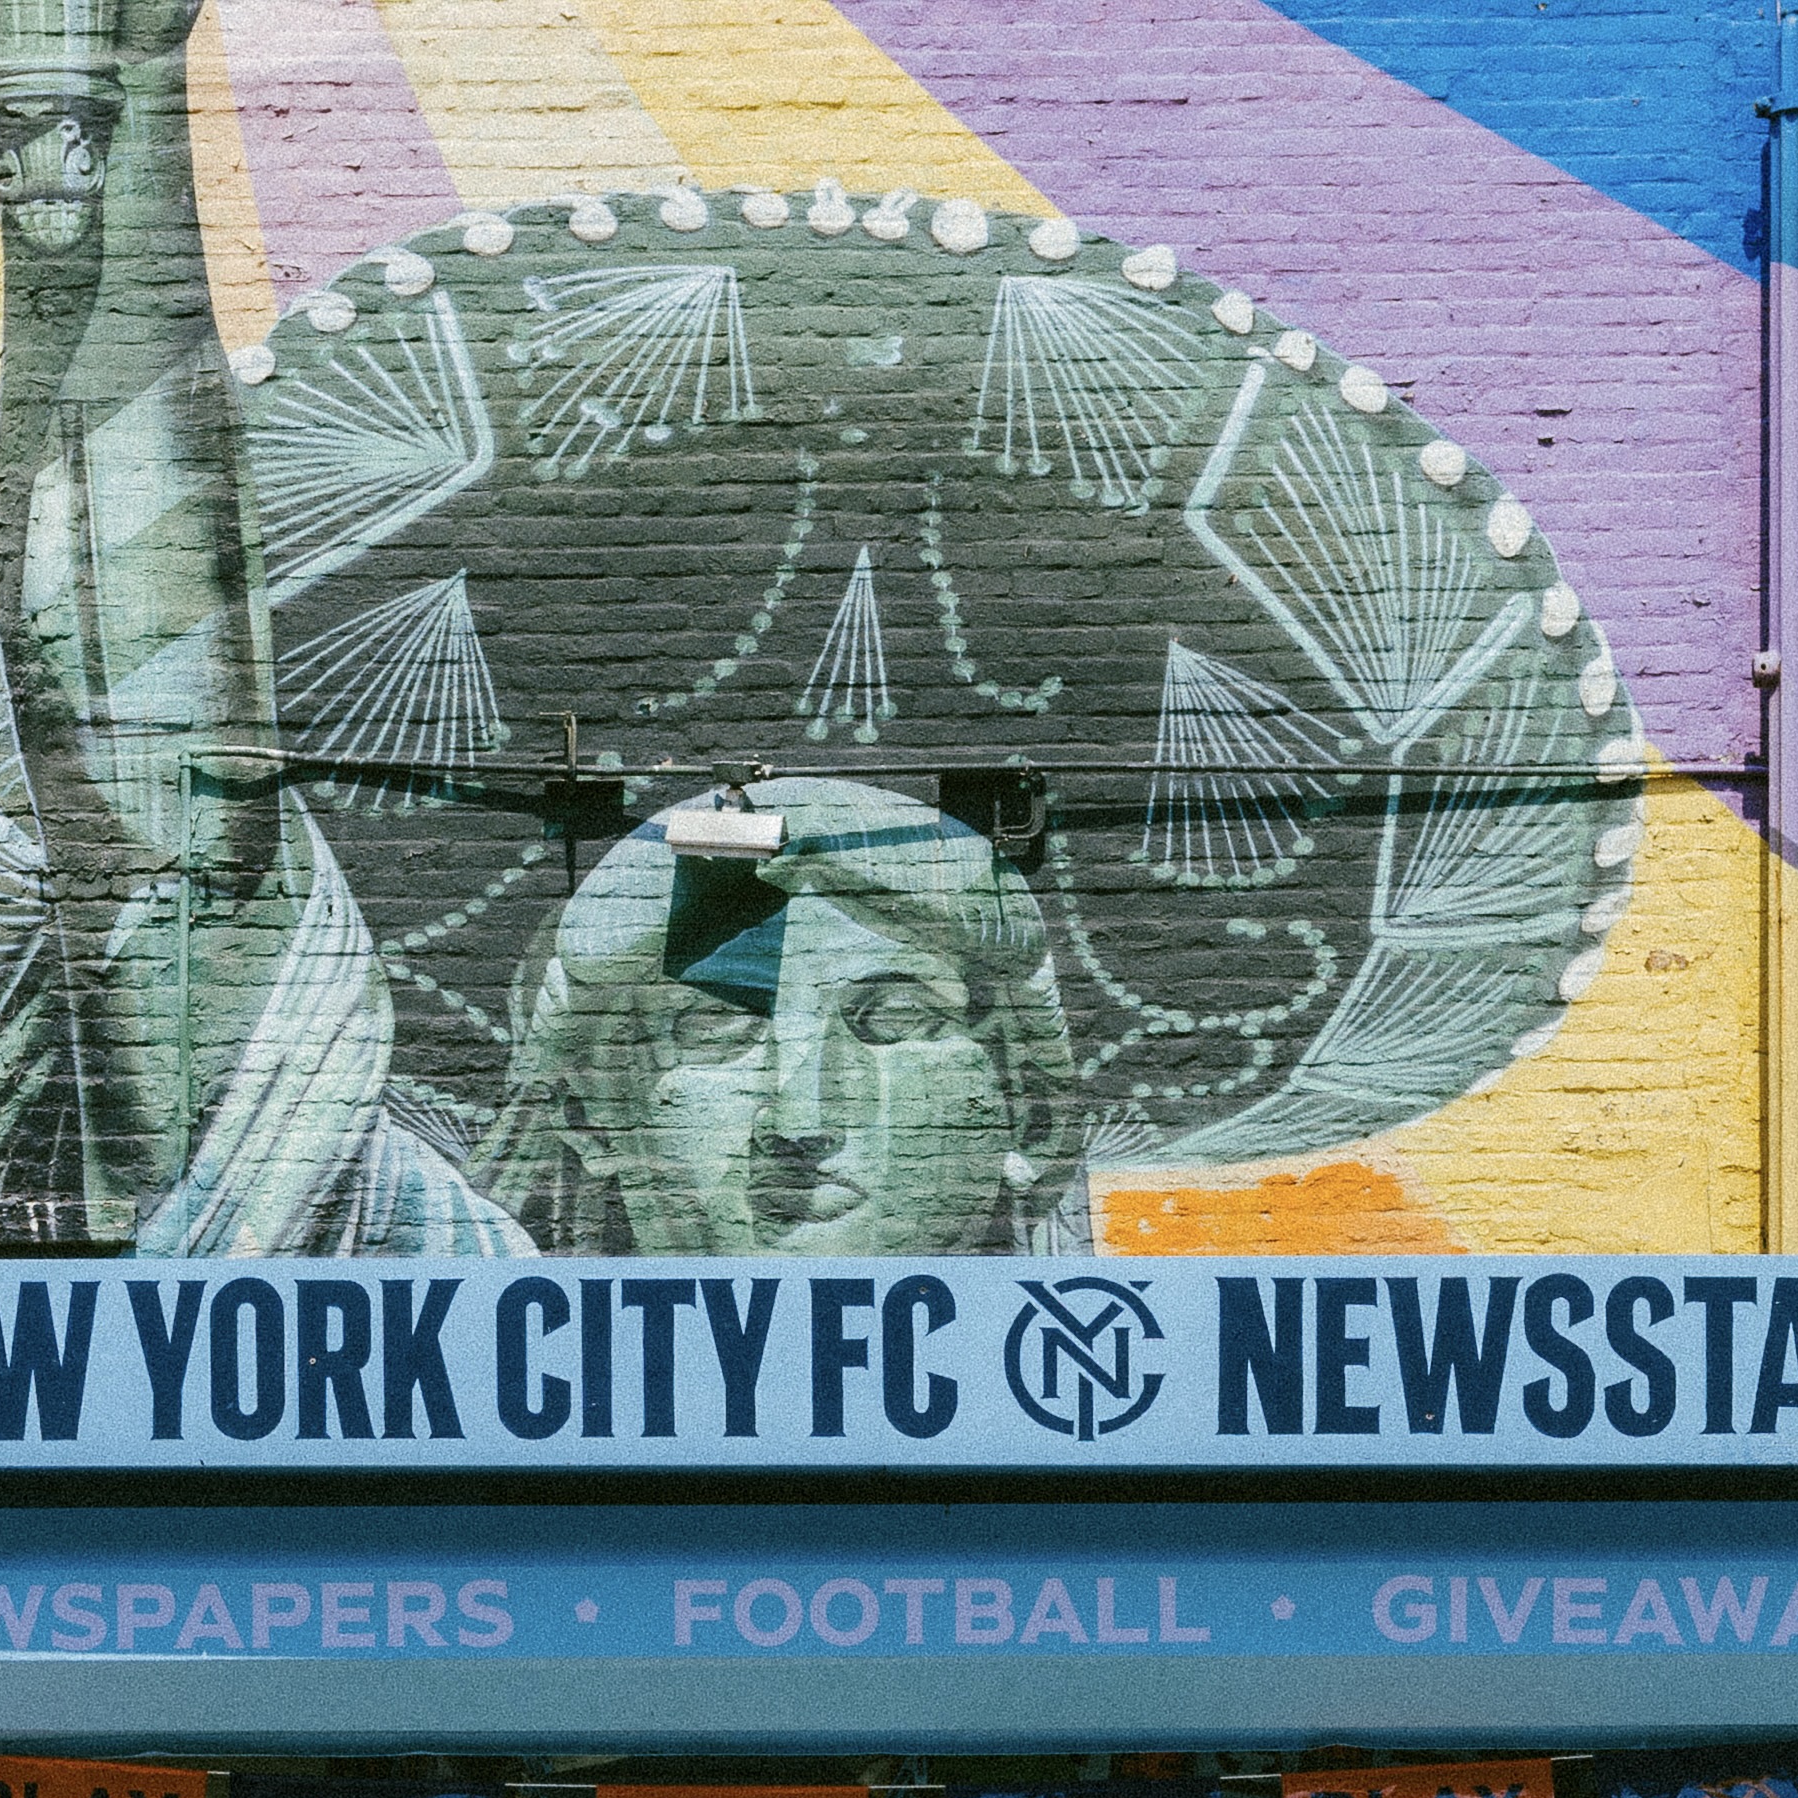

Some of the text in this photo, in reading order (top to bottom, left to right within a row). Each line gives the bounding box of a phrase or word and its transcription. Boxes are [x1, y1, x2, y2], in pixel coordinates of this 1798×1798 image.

[127, 1278, 465, 1442] YORK
[496, 1275, 781, 1440] CITY
[810, 1273, 958, 1441] FC
[673, 1576, 1210, 1648] FOOTBALL
